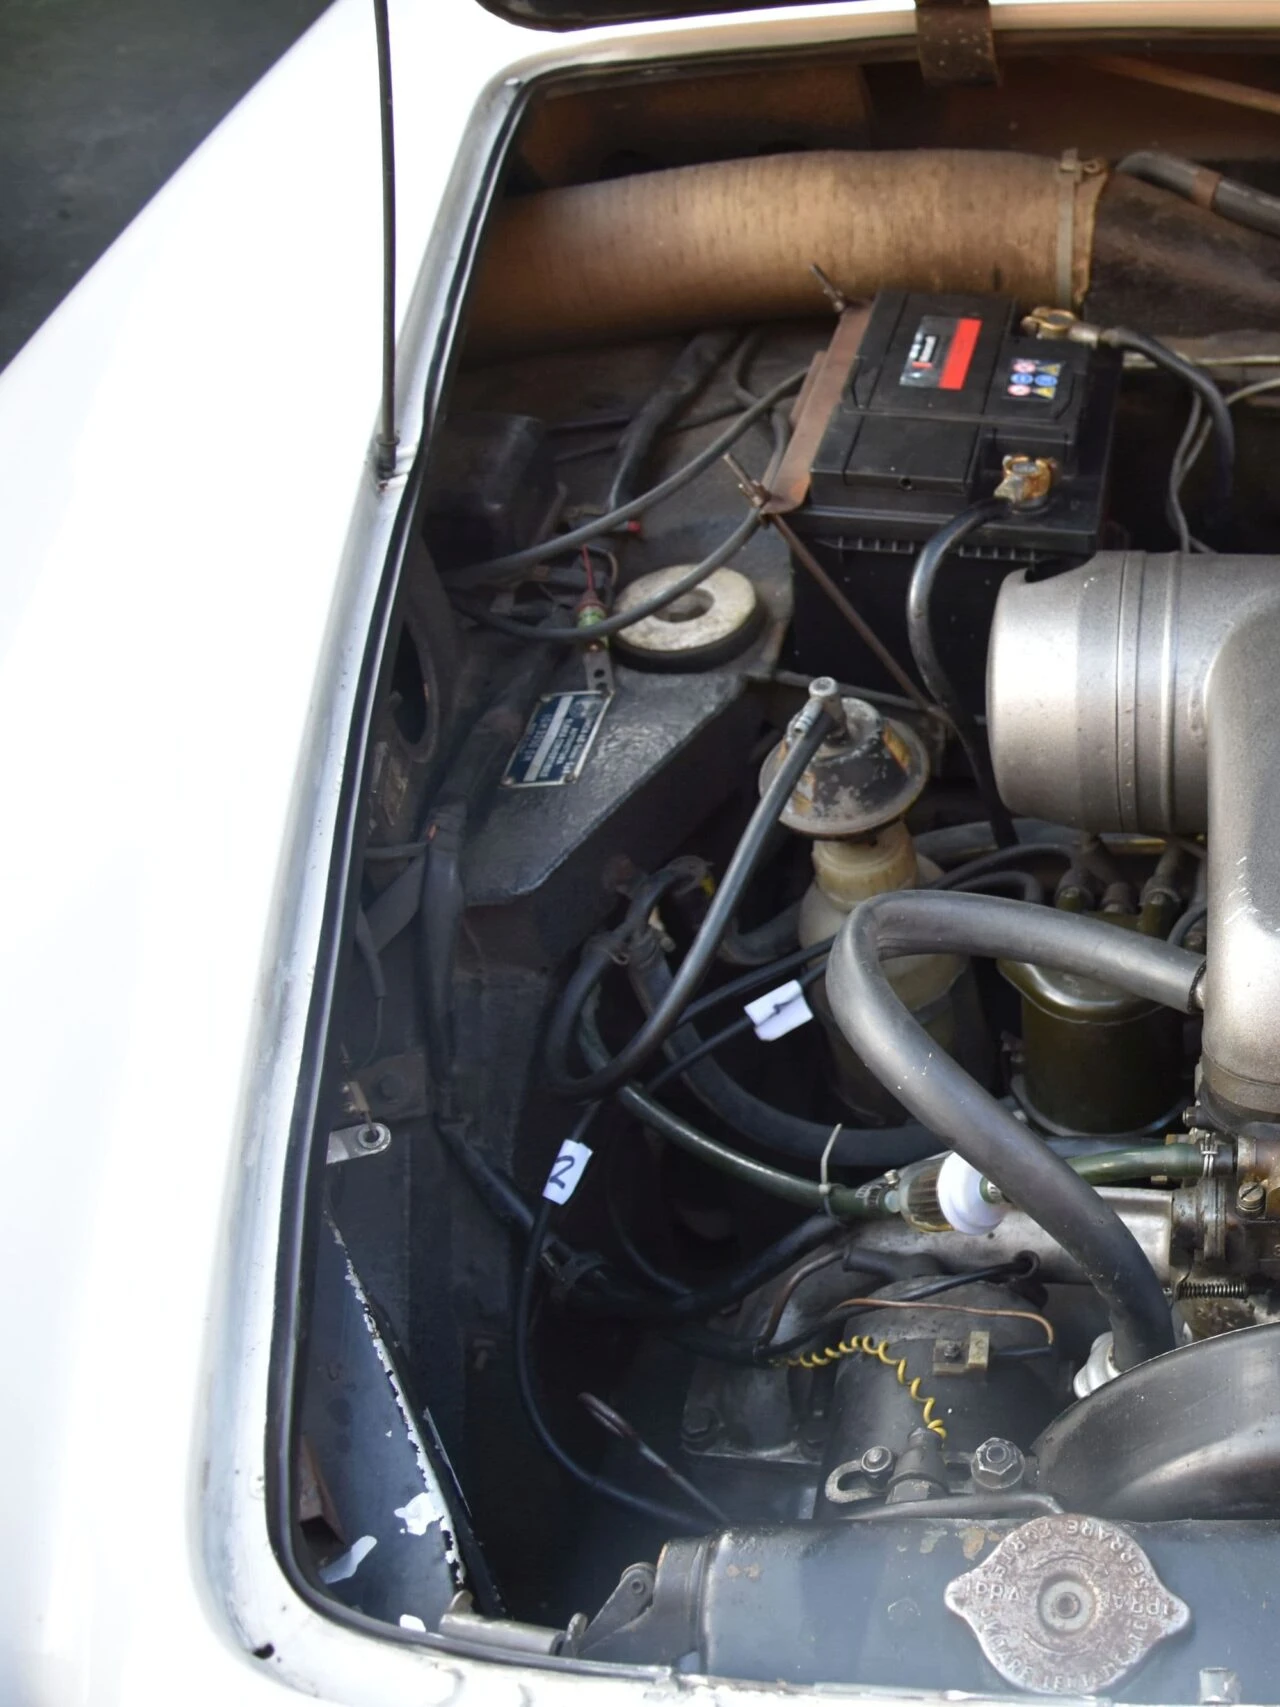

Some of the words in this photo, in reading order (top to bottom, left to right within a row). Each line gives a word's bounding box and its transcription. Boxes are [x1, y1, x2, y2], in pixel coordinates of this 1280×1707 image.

[549, 1155, 575, 1189] 2
[1066, 1518, 1151, 1588] SERRARE
[966, 1581, 1021, 1601] IPRA
[1111, 1593, 1169, 1615] IPRA
